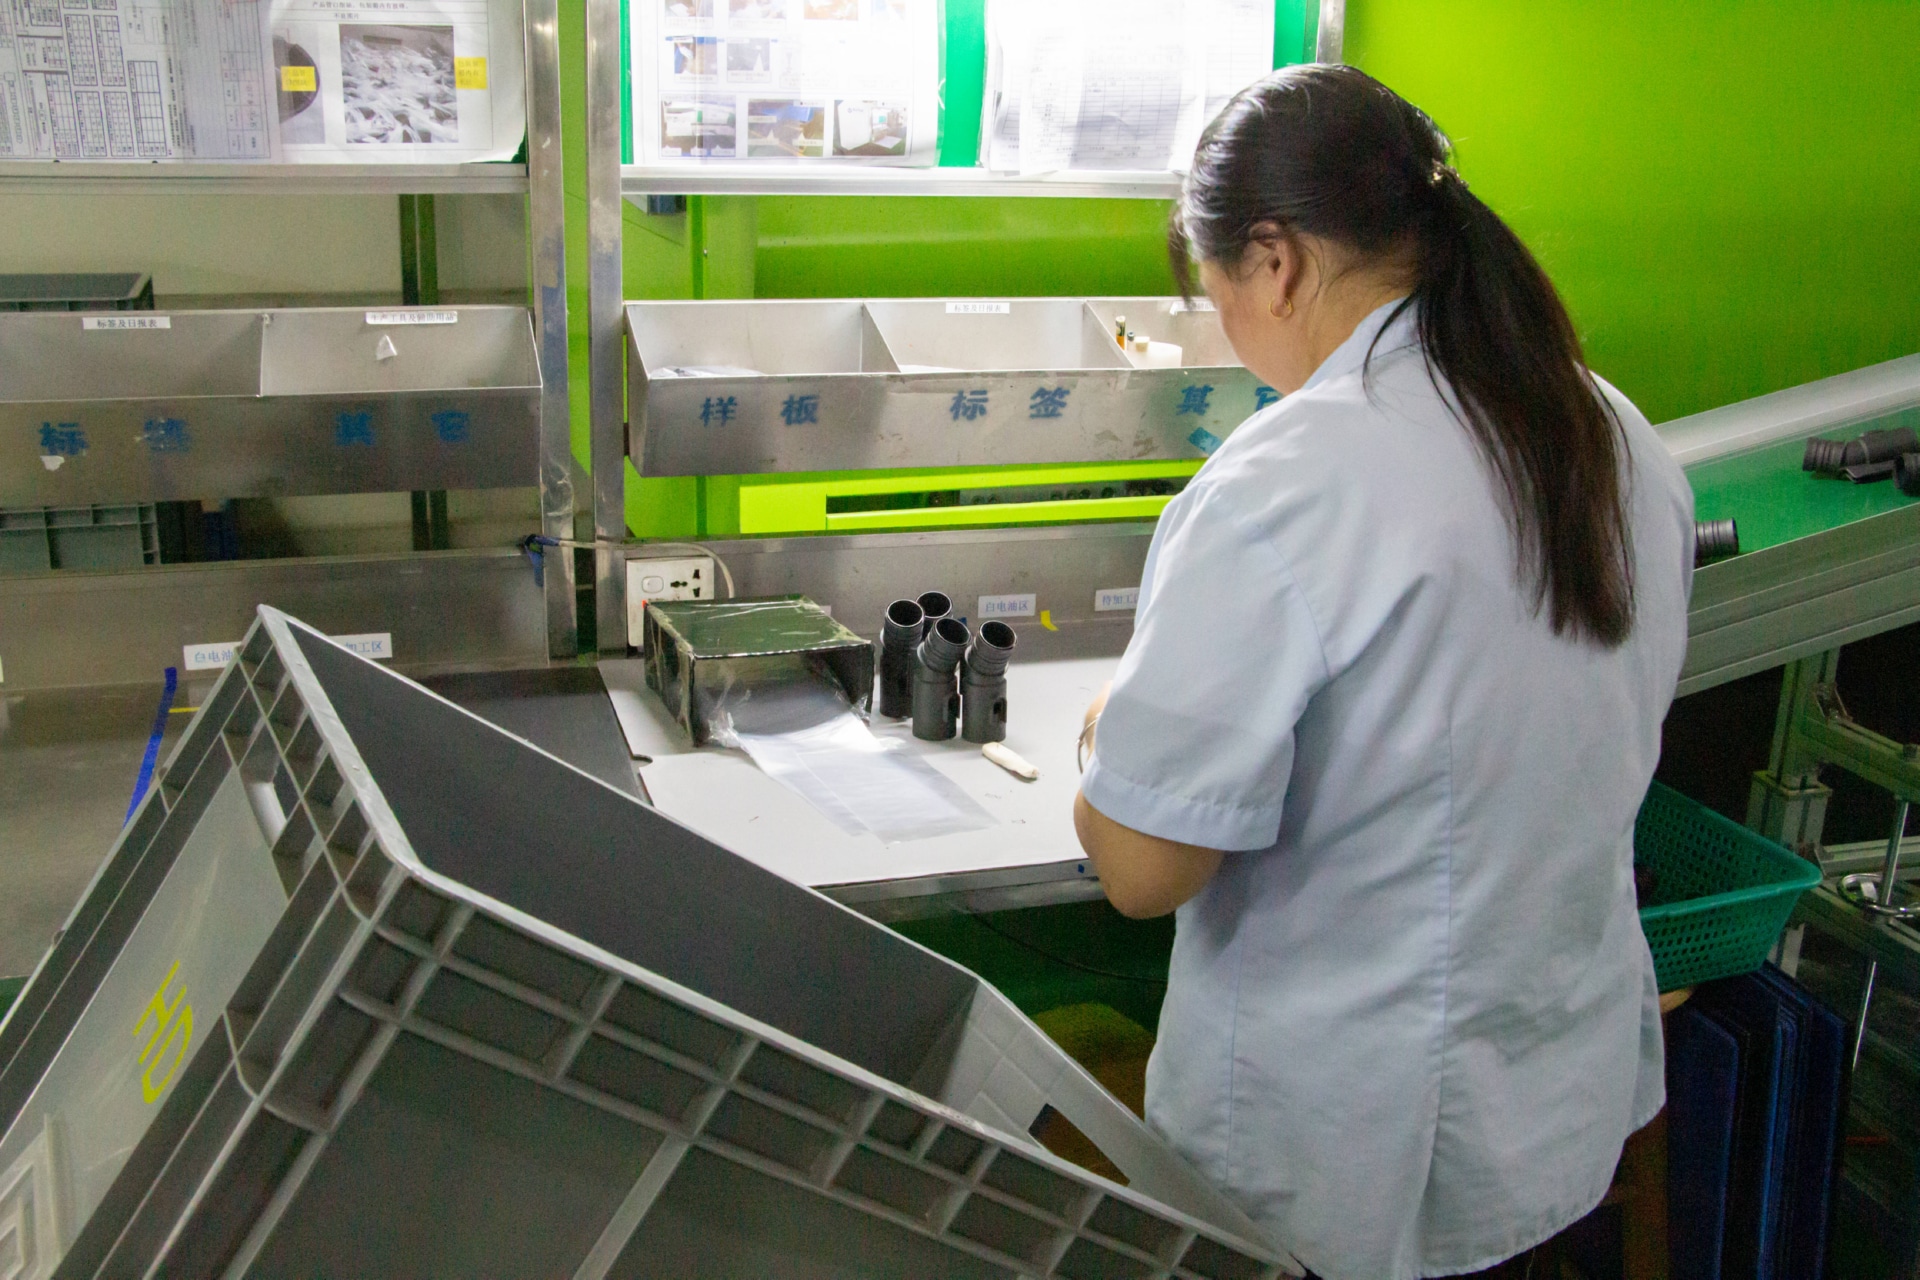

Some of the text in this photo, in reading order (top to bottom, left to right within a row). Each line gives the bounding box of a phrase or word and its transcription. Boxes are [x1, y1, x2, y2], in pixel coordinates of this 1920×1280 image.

[97, 319, 158, 329] 标签及日报表
[700, 395, 820, 427] 样板
[949, 387, 1071, 421] 标签
[985, 599, 1029, 613] 白电油区
